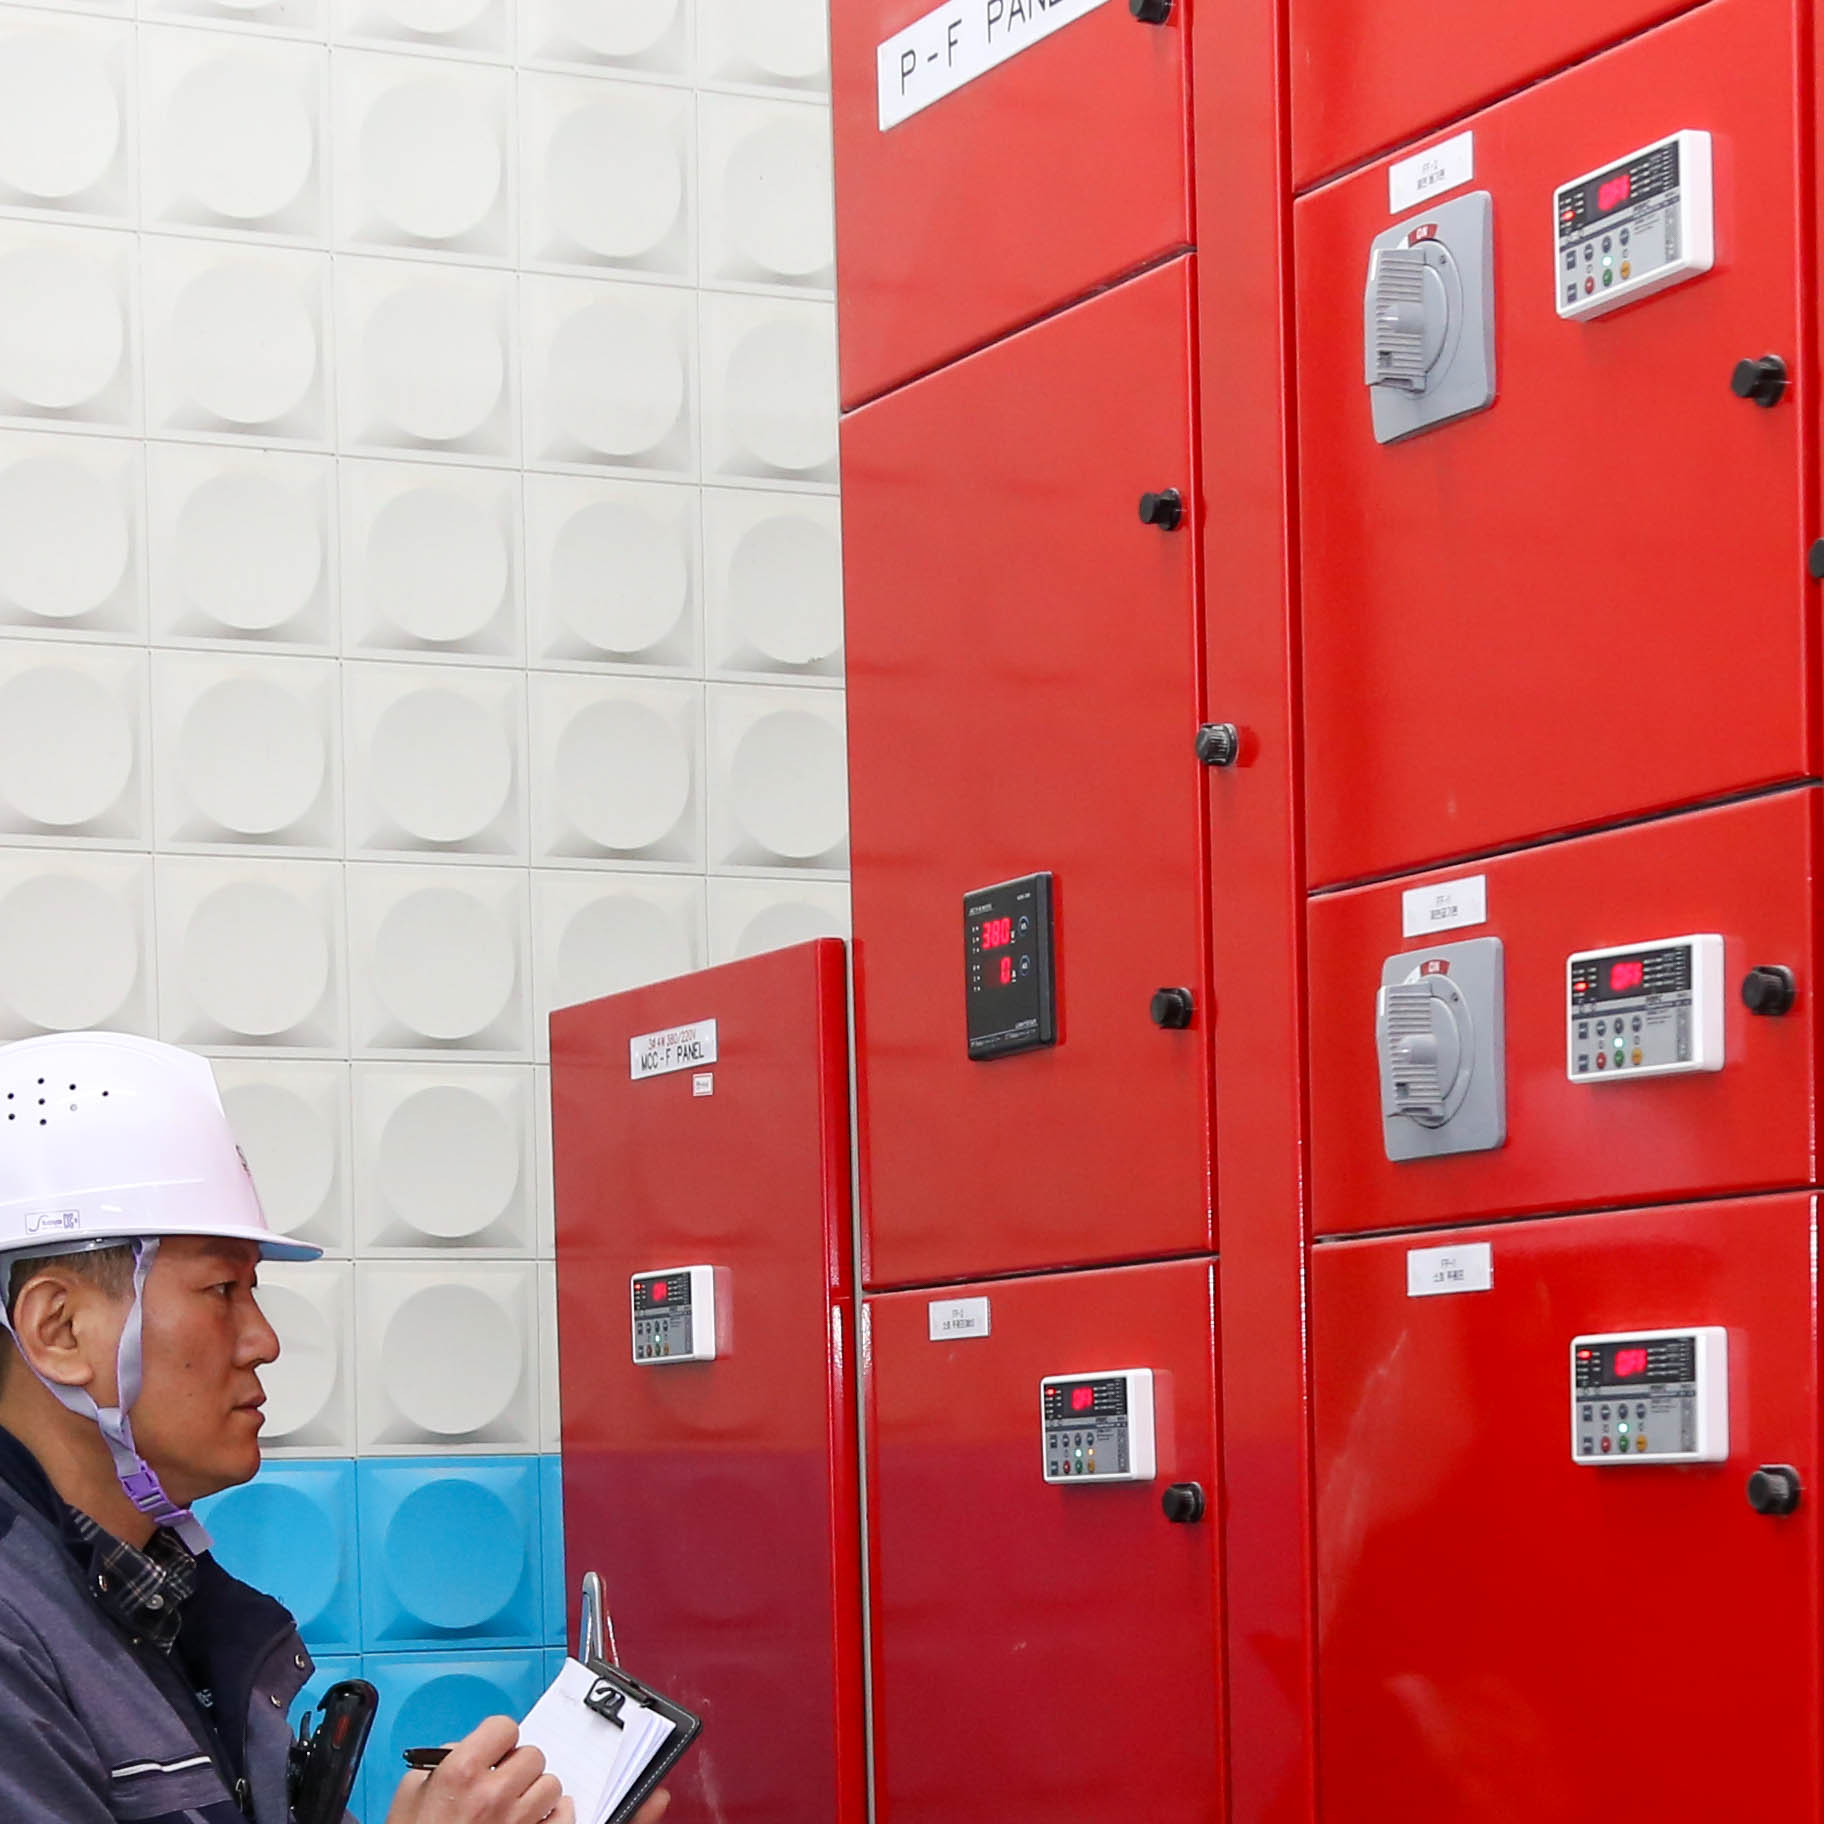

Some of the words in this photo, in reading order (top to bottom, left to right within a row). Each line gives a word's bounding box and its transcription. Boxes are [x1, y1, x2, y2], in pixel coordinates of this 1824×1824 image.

[986, 0, 1066, 44] PA
[982, 916, 1012, 950] 380
[676, 1041, 705, 1064] PANEL
